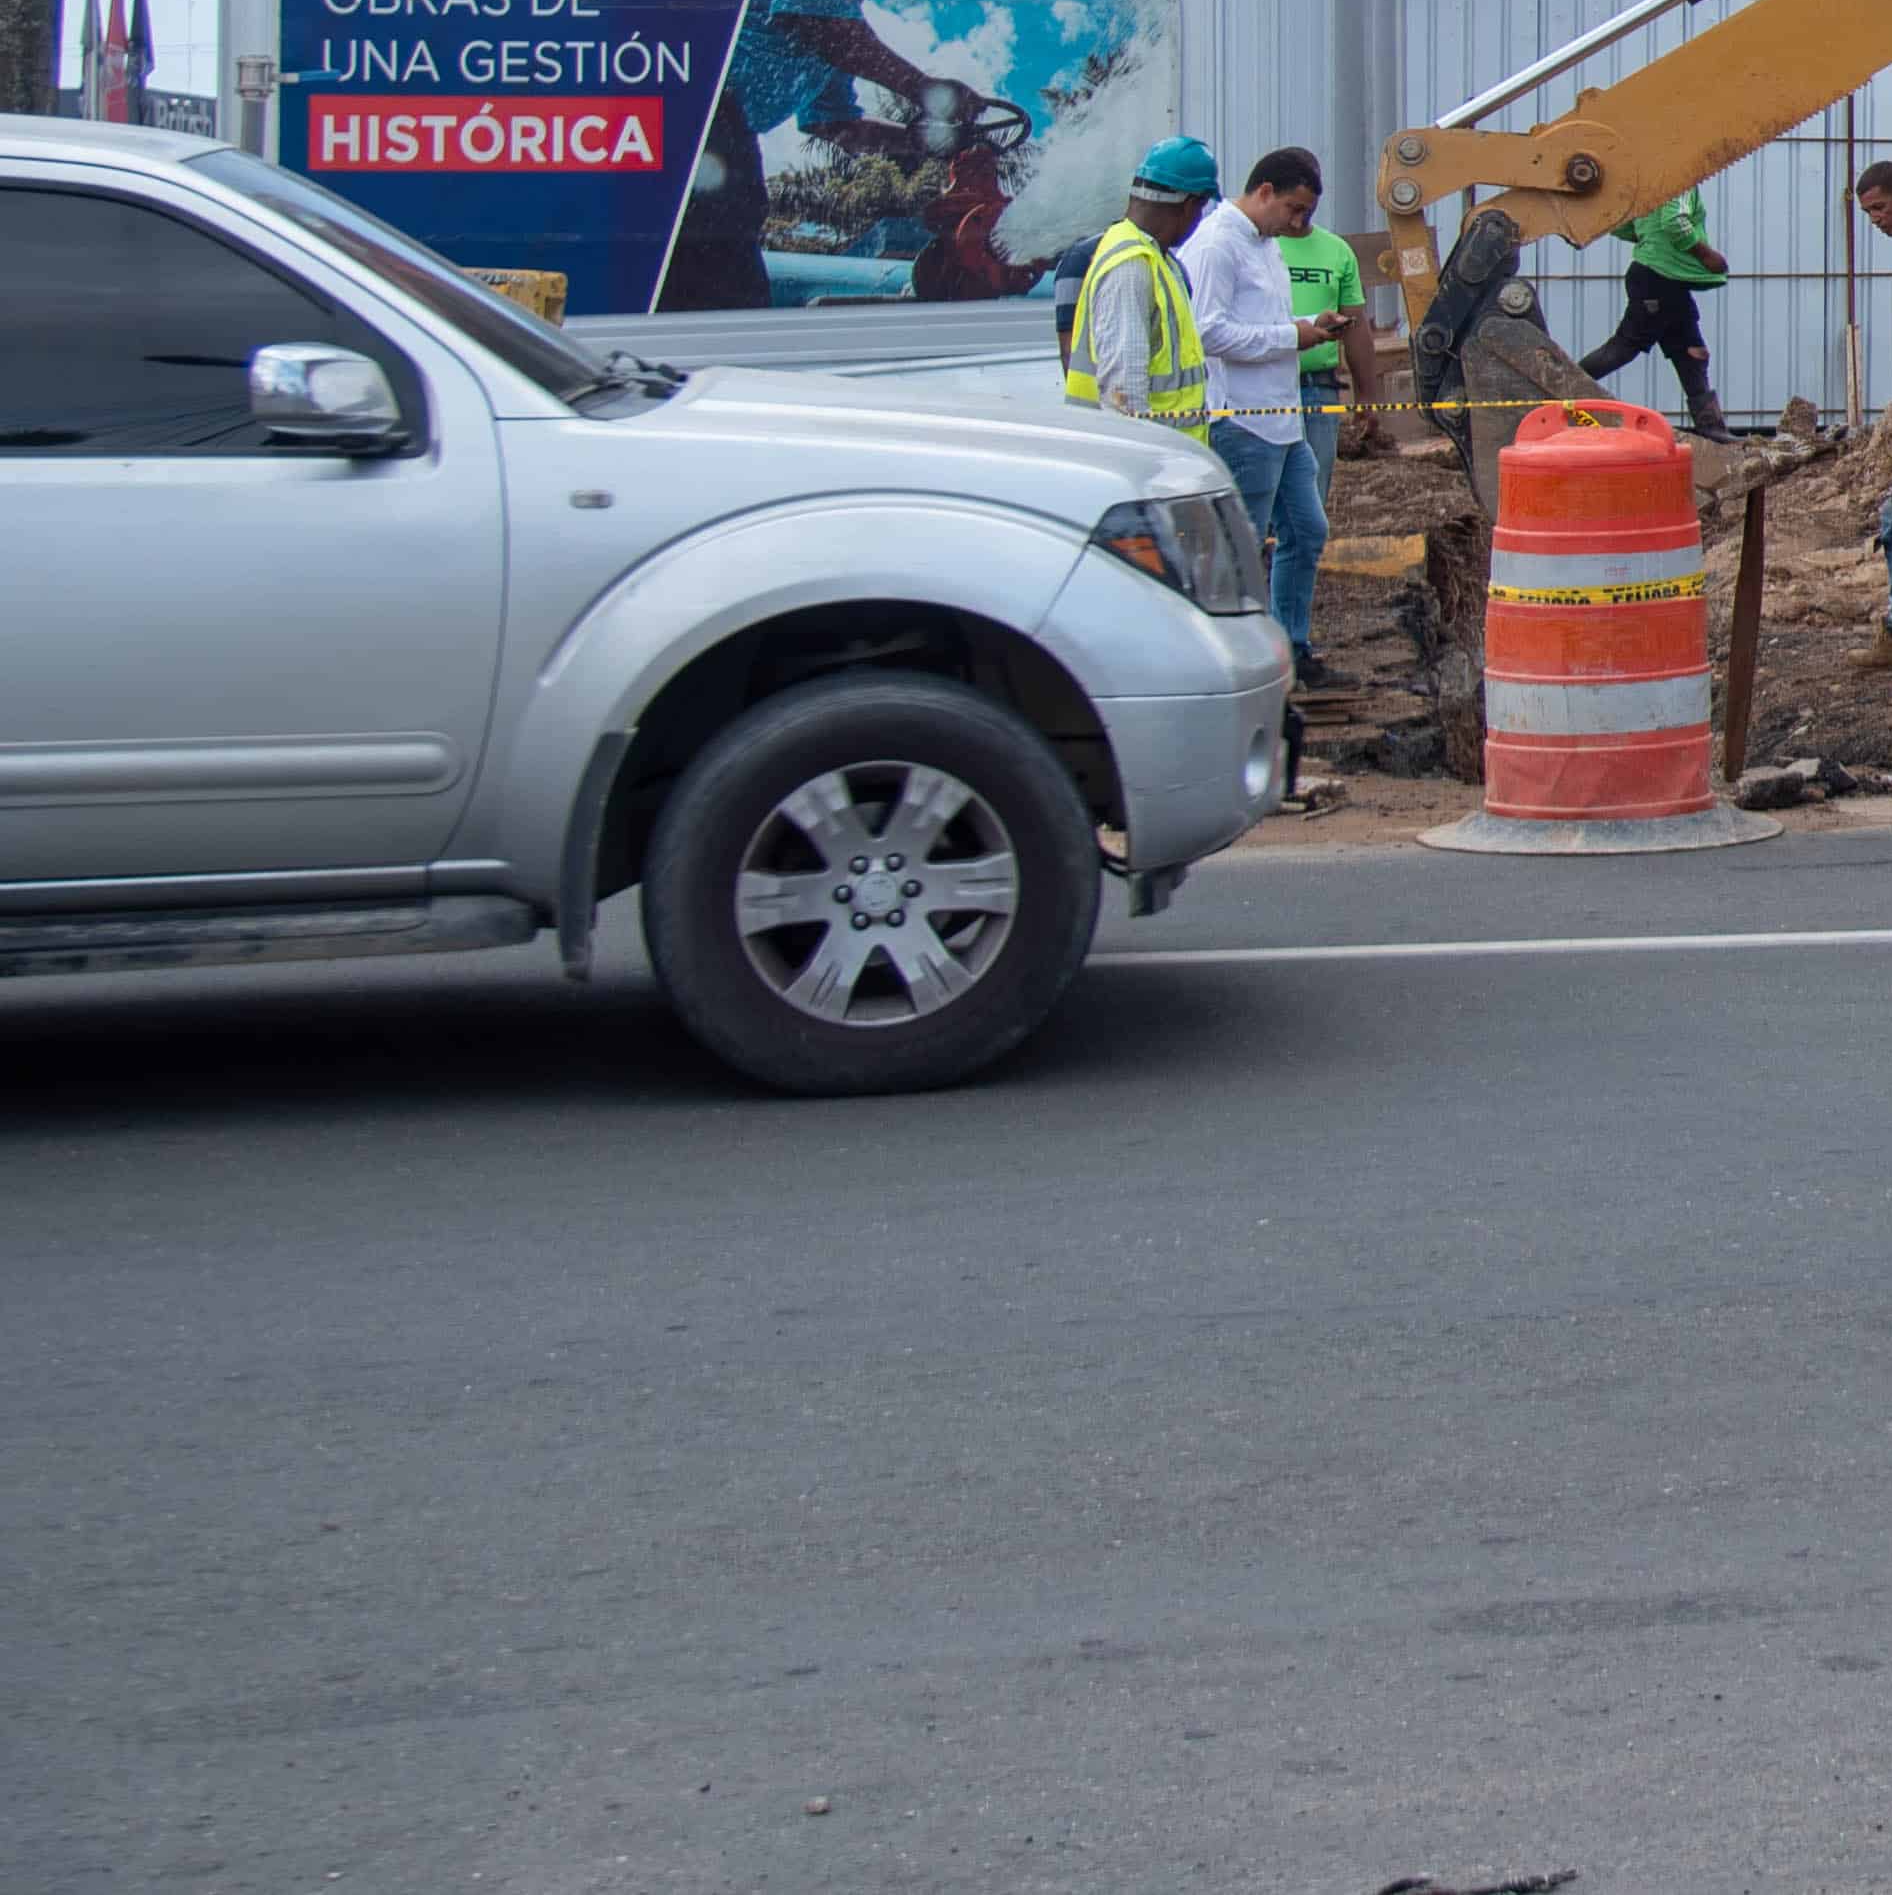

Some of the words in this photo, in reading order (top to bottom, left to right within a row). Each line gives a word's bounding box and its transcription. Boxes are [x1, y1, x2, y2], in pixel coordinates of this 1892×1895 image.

[322, 39, 441, 83] UNA
[459, 31, 691, 84] GESTIÓN
[321, 102, 654, 164] HISTÓRICA
